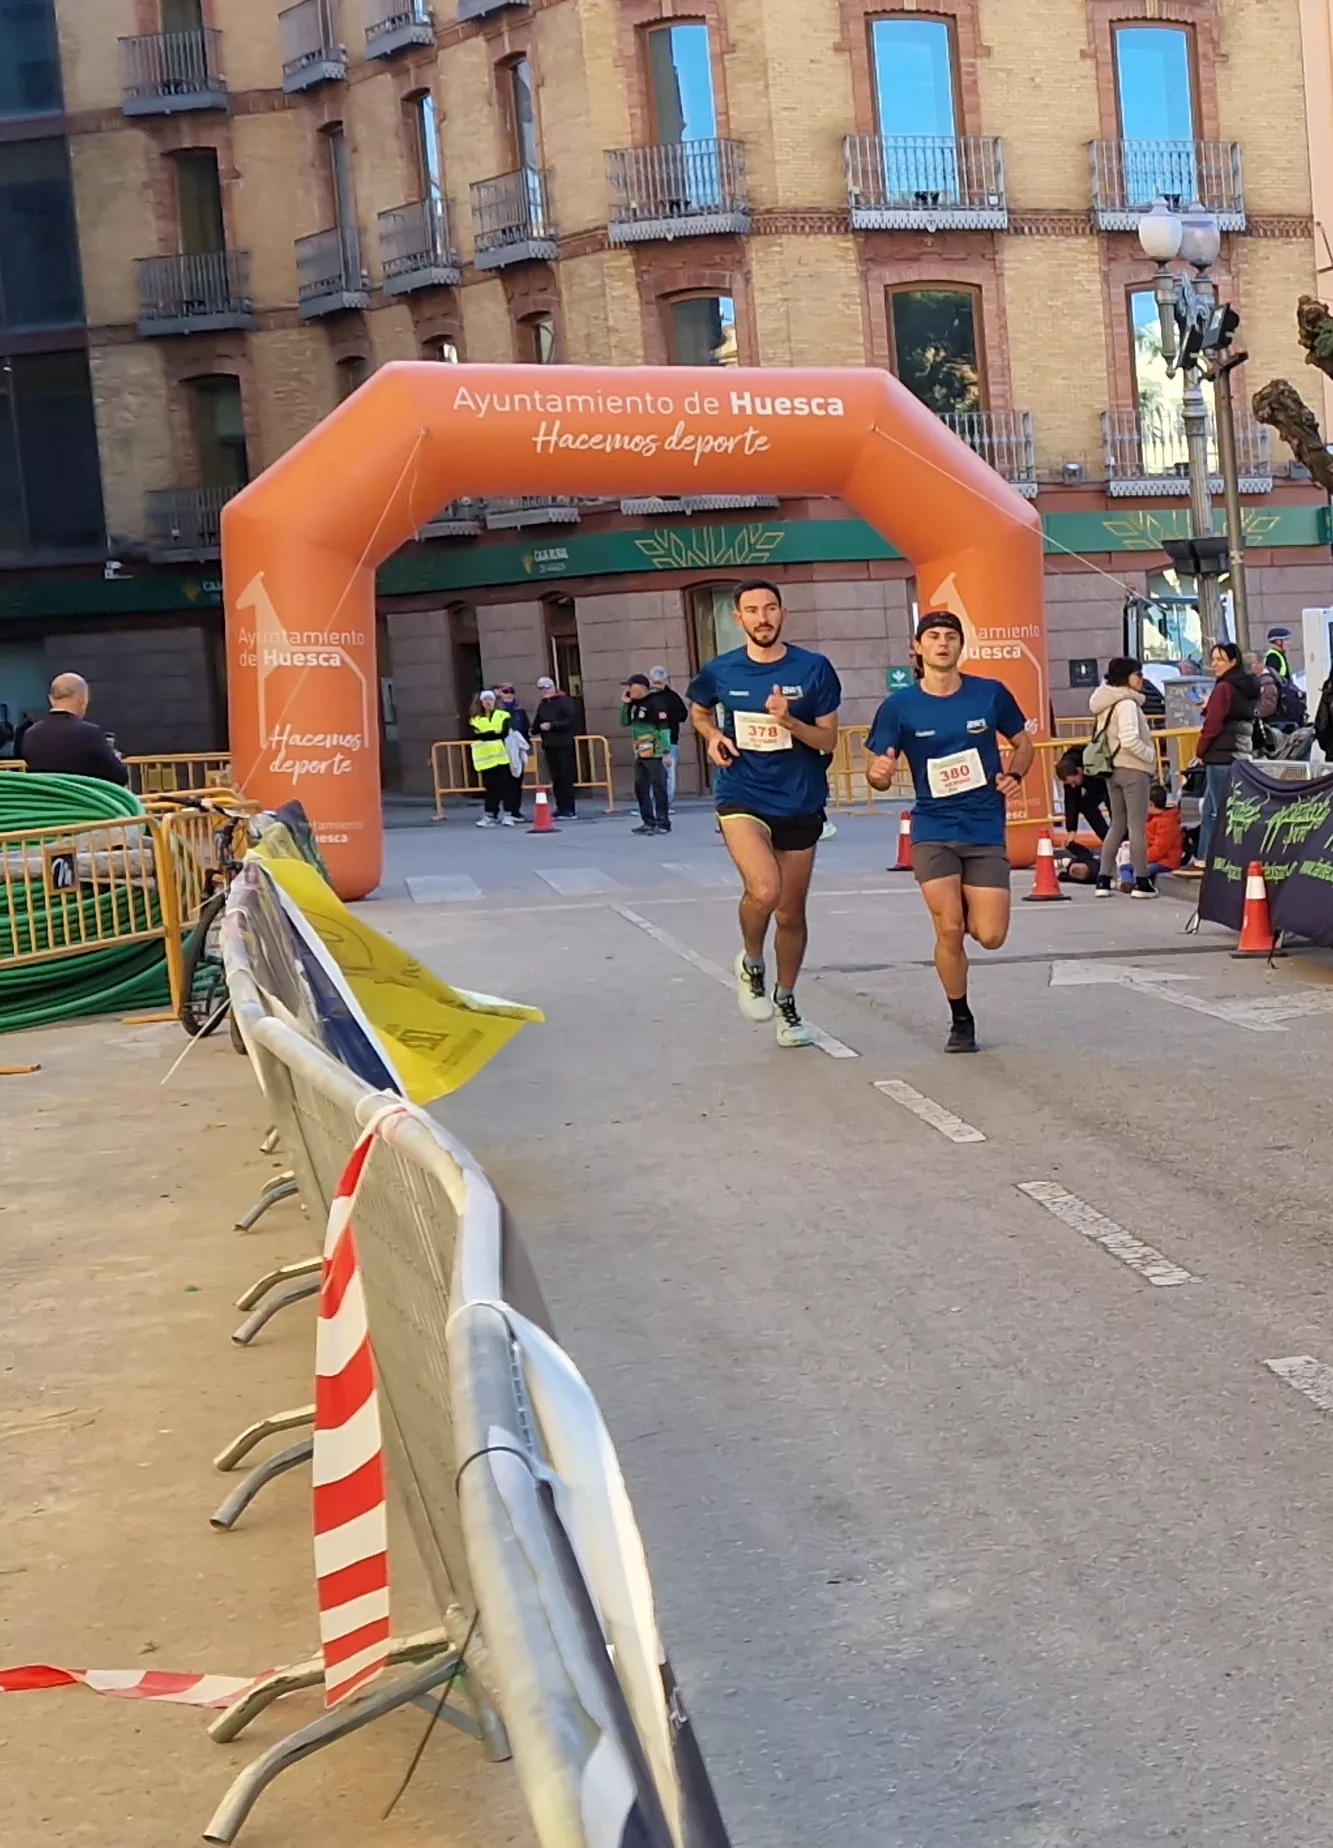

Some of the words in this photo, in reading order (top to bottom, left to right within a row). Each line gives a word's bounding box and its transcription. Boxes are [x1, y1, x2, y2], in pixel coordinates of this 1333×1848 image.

[453, 386, 674, 417] Ayuntamiento
[684, 391, 720, 415] de
[730, 391, 844, 416] Huesca
[532, 420, 660, 455] Hacemos
[664, 423, 771, 466] deporte
[238, 626, 365, 649] Ayuntamiento
[239, 652, 257, 667] de
[263, 650, 341, 667] Huesca
[269, 723, 362, 751] Hacemos
[748, 725, 778, 738] 378
[269, 750, 352, 785] deporte
[940, 765, 970, 782] 380
